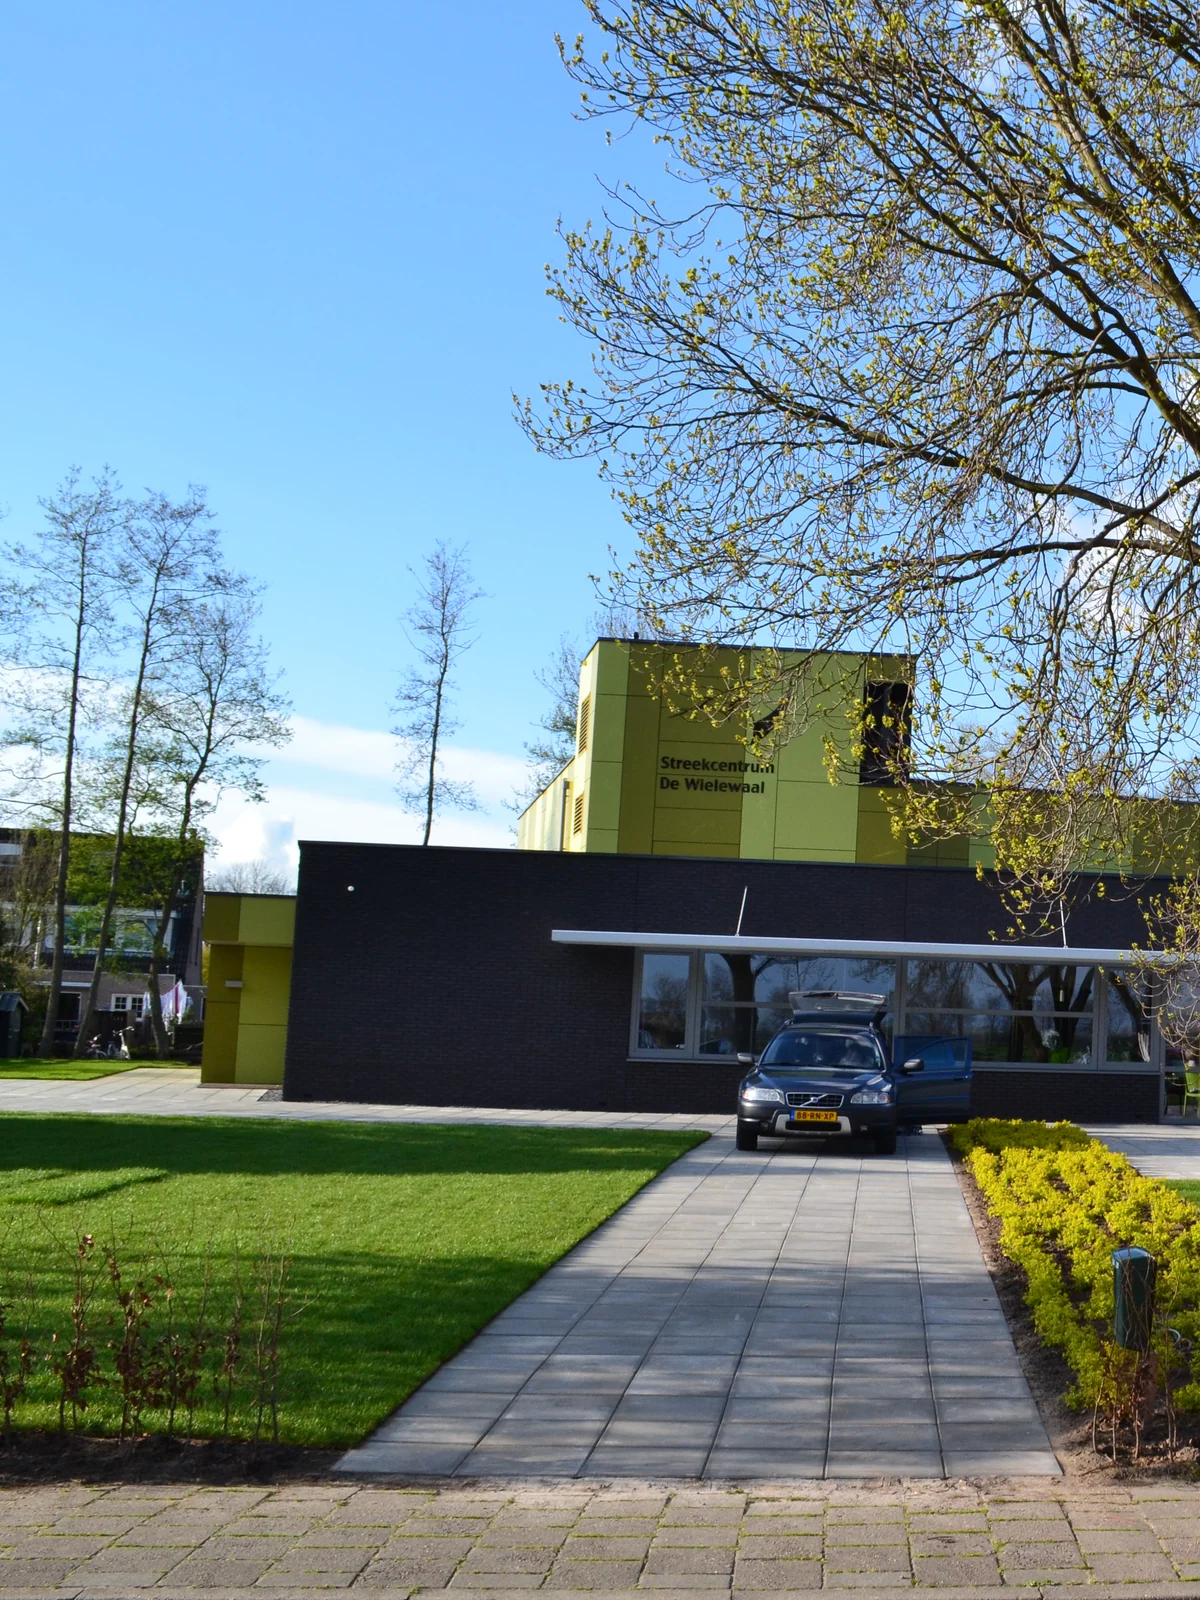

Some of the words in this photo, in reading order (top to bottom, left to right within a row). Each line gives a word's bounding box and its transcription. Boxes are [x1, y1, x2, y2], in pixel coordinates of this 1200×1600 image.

[660, 756, 775, 774] Streekcentrum
[659, 776, 680, 790] De
[684, 777, 766, 794] Wielewaal
[796, 1111, 835, 1121] 88-RN-XP
